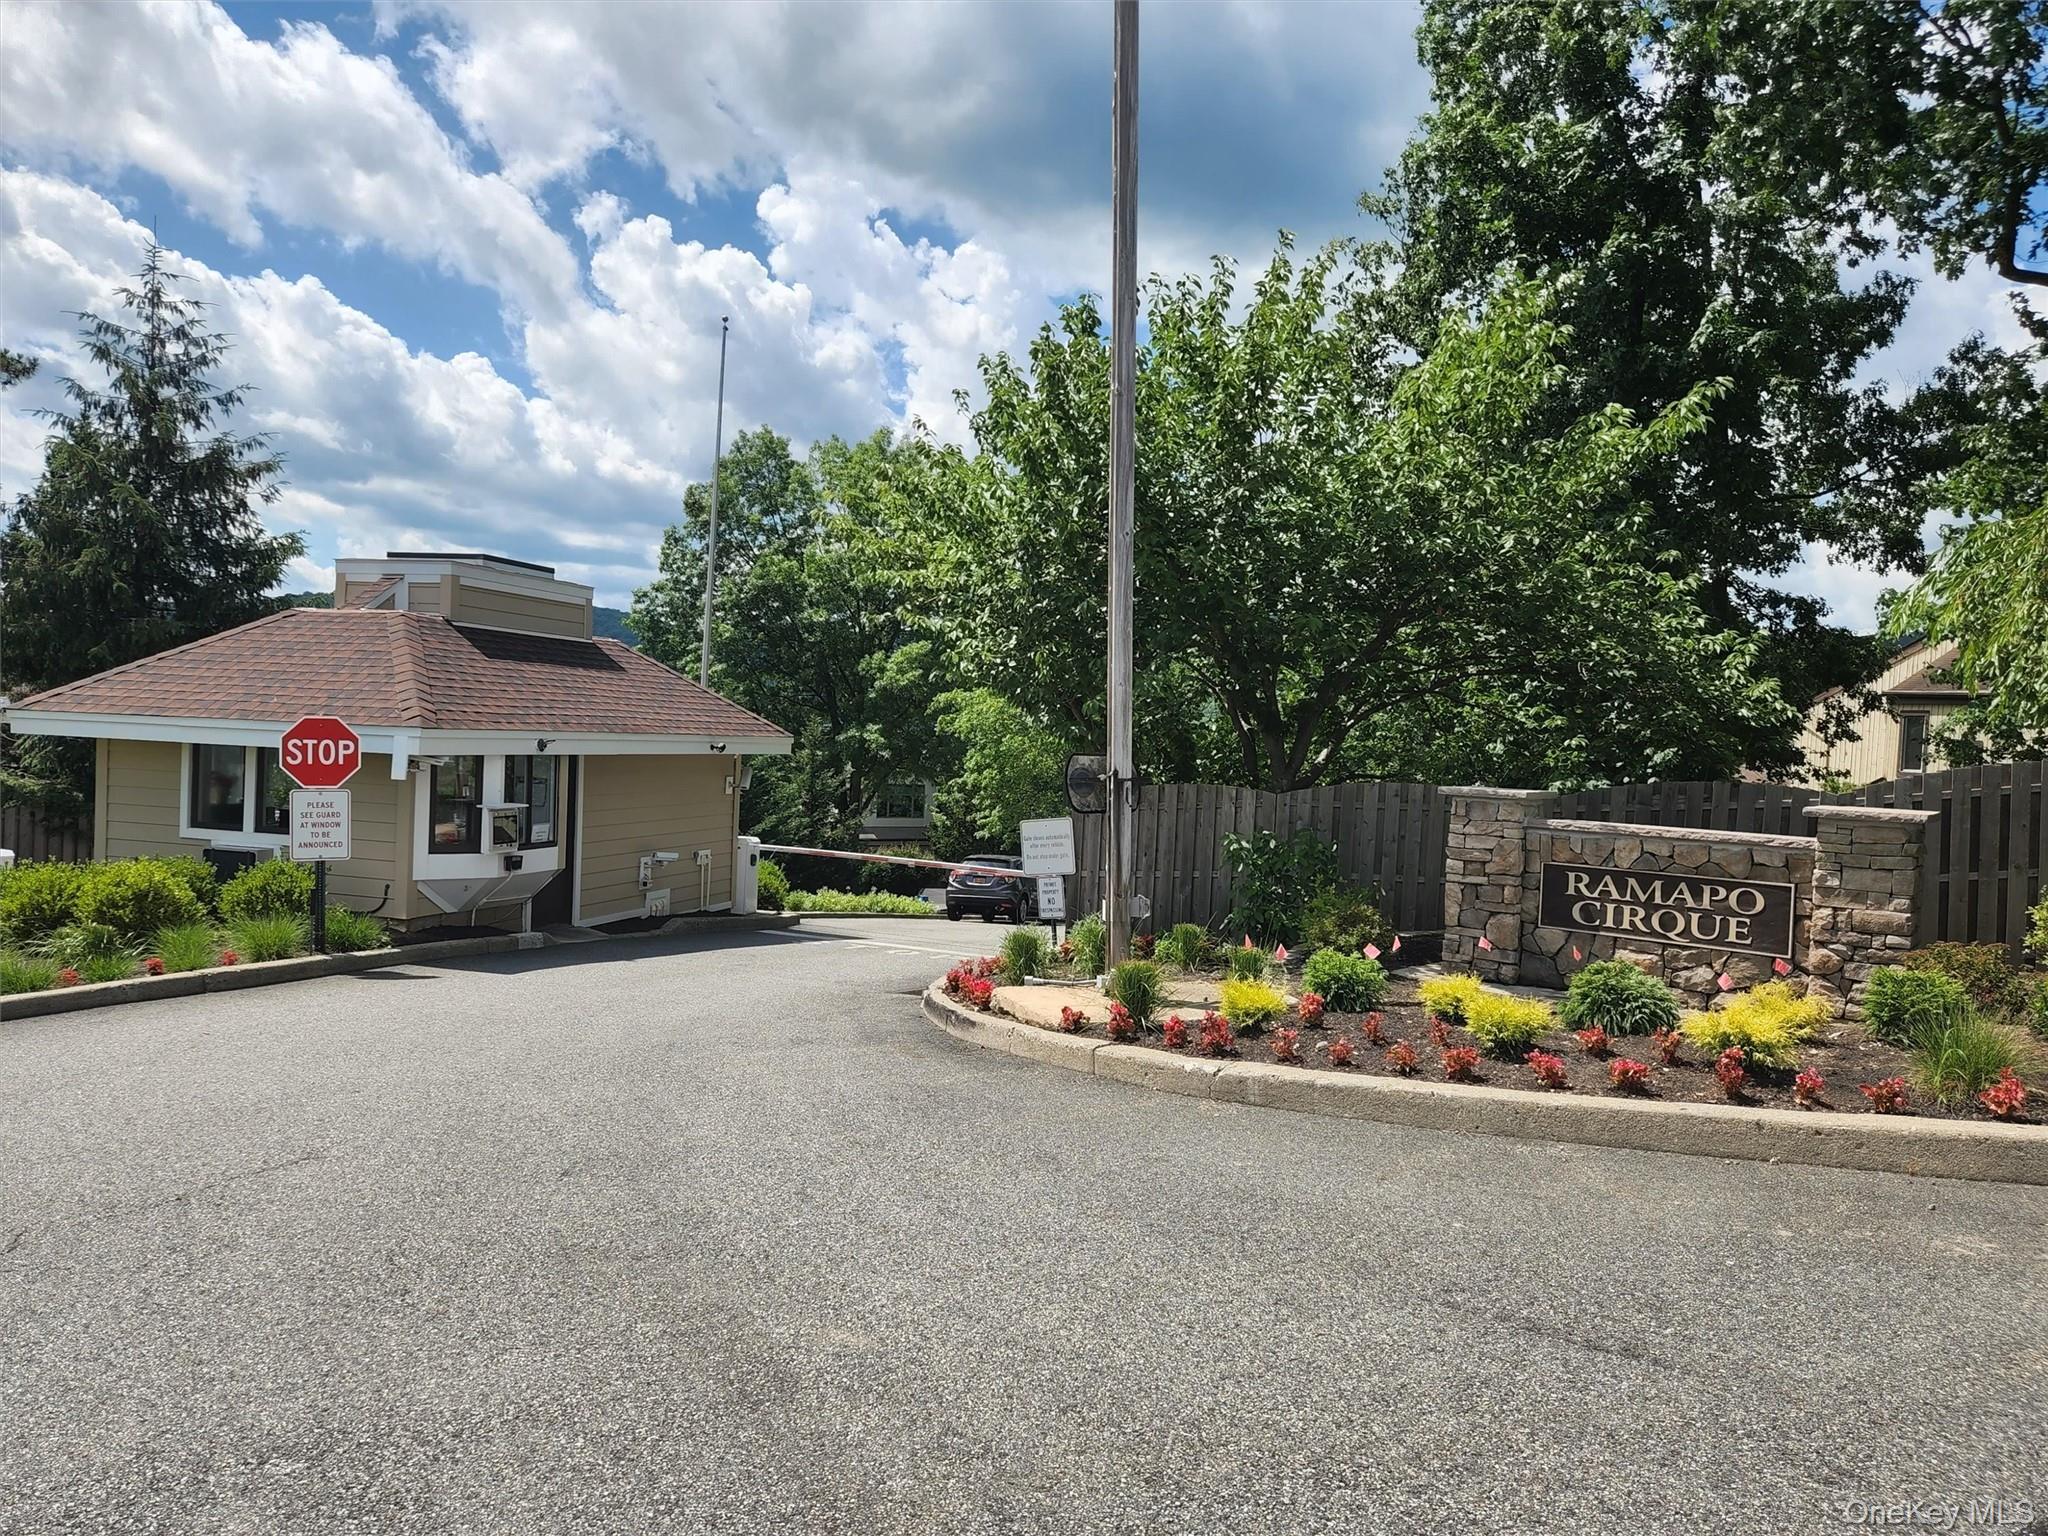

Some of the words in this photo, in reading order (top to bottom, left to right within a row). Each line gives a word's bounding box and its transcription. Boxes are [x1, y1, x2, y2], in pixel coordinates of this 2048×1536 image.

[286, 738, 355, 766] STOP
[306, 801, 335, 809] PLEASE
[315, 811, 341, 819] GUARD
[300, 821, 309, 829] AT
[310, 821, 341, 829] WINDOW
[310, 831, 320, 839] TO
[321, 831, 332, 839] BE
[298, 841, 343, 849] ANNOUNCED
[1565, 871, 1766, 915] RAMAPO
[1047, 897, 1056, 905] NO
[1571, 900, 1753, 945] CIRQUE
